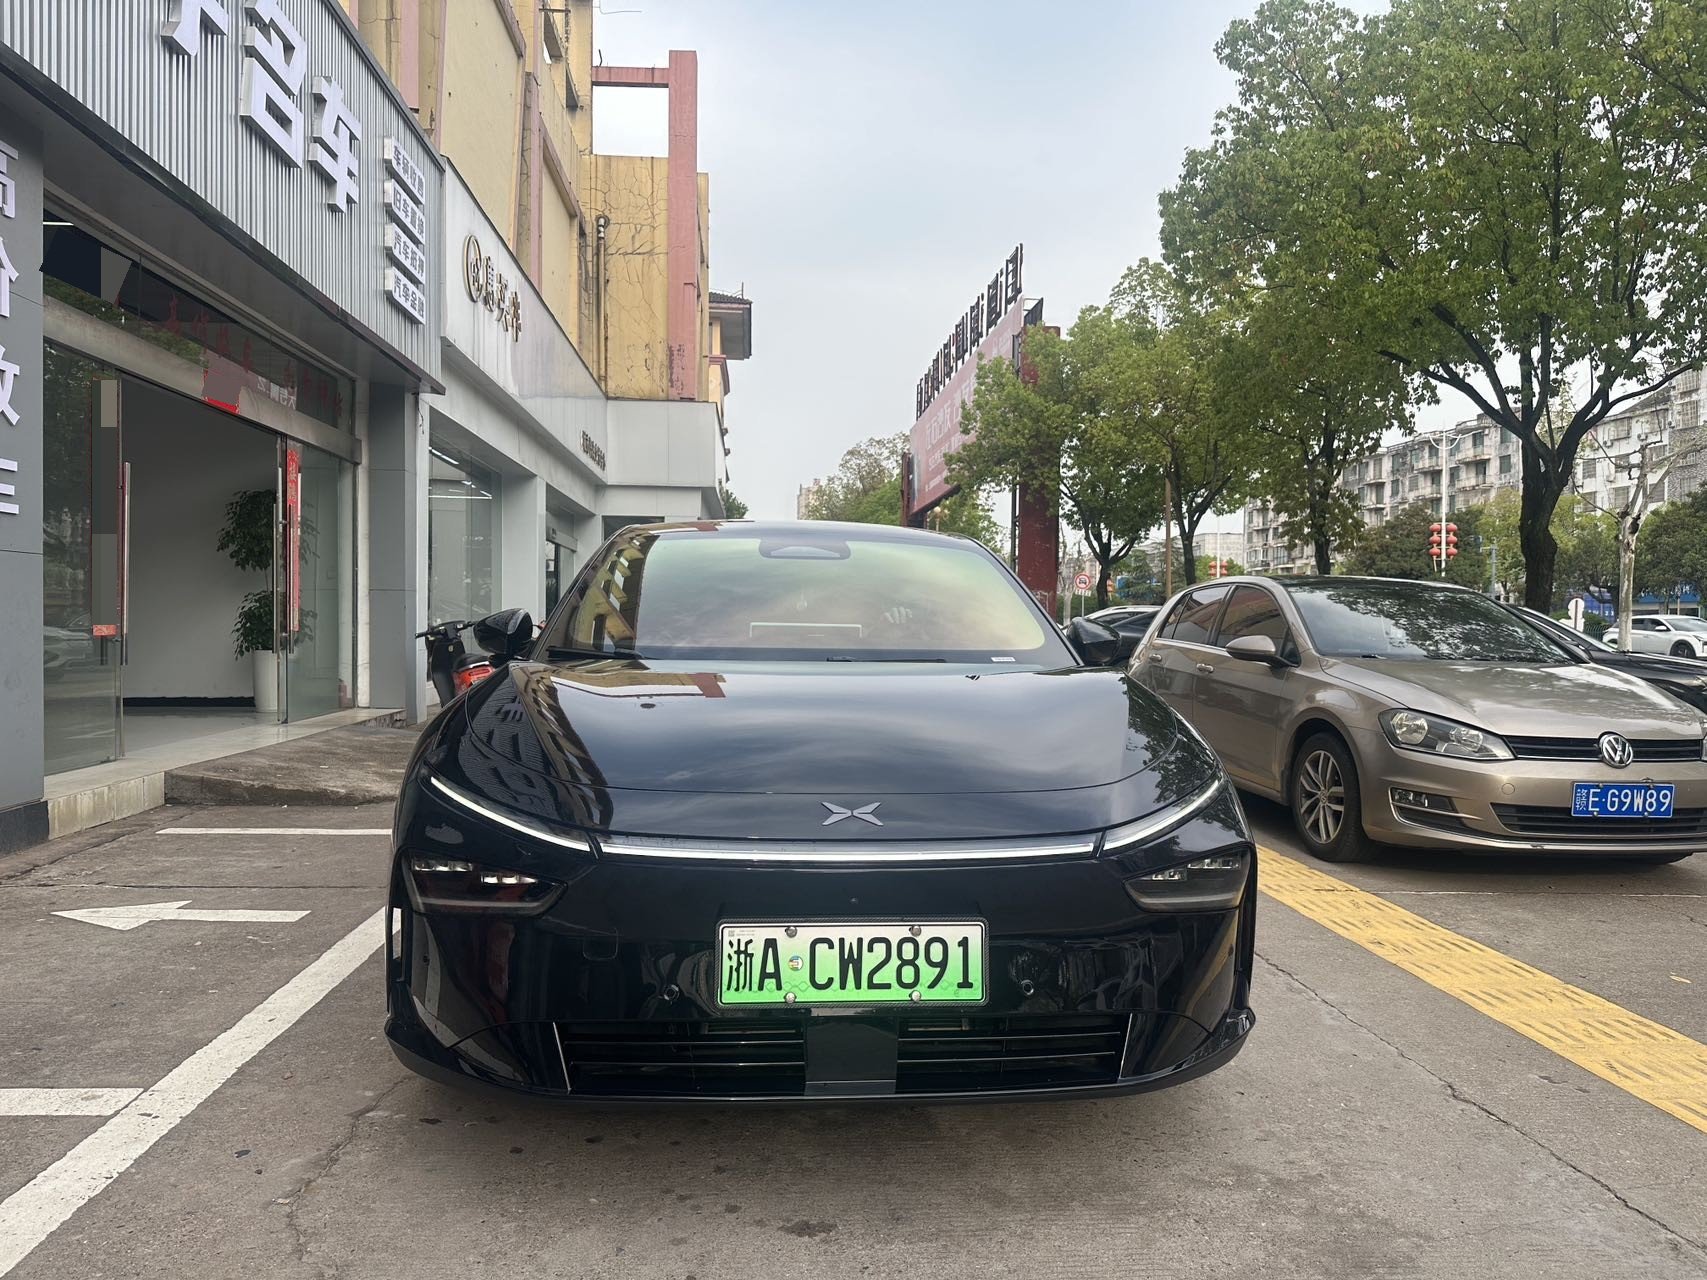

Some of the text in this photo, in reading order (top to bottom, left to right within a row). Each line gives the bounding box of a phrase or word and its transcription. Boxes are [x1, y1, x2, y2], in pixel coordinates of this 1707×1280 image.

[393, 188, 425, 239] 旧车置换
[393, 229, 425, 279] 汽车抵押
[393, 275, 425, 318] 汽车金融
